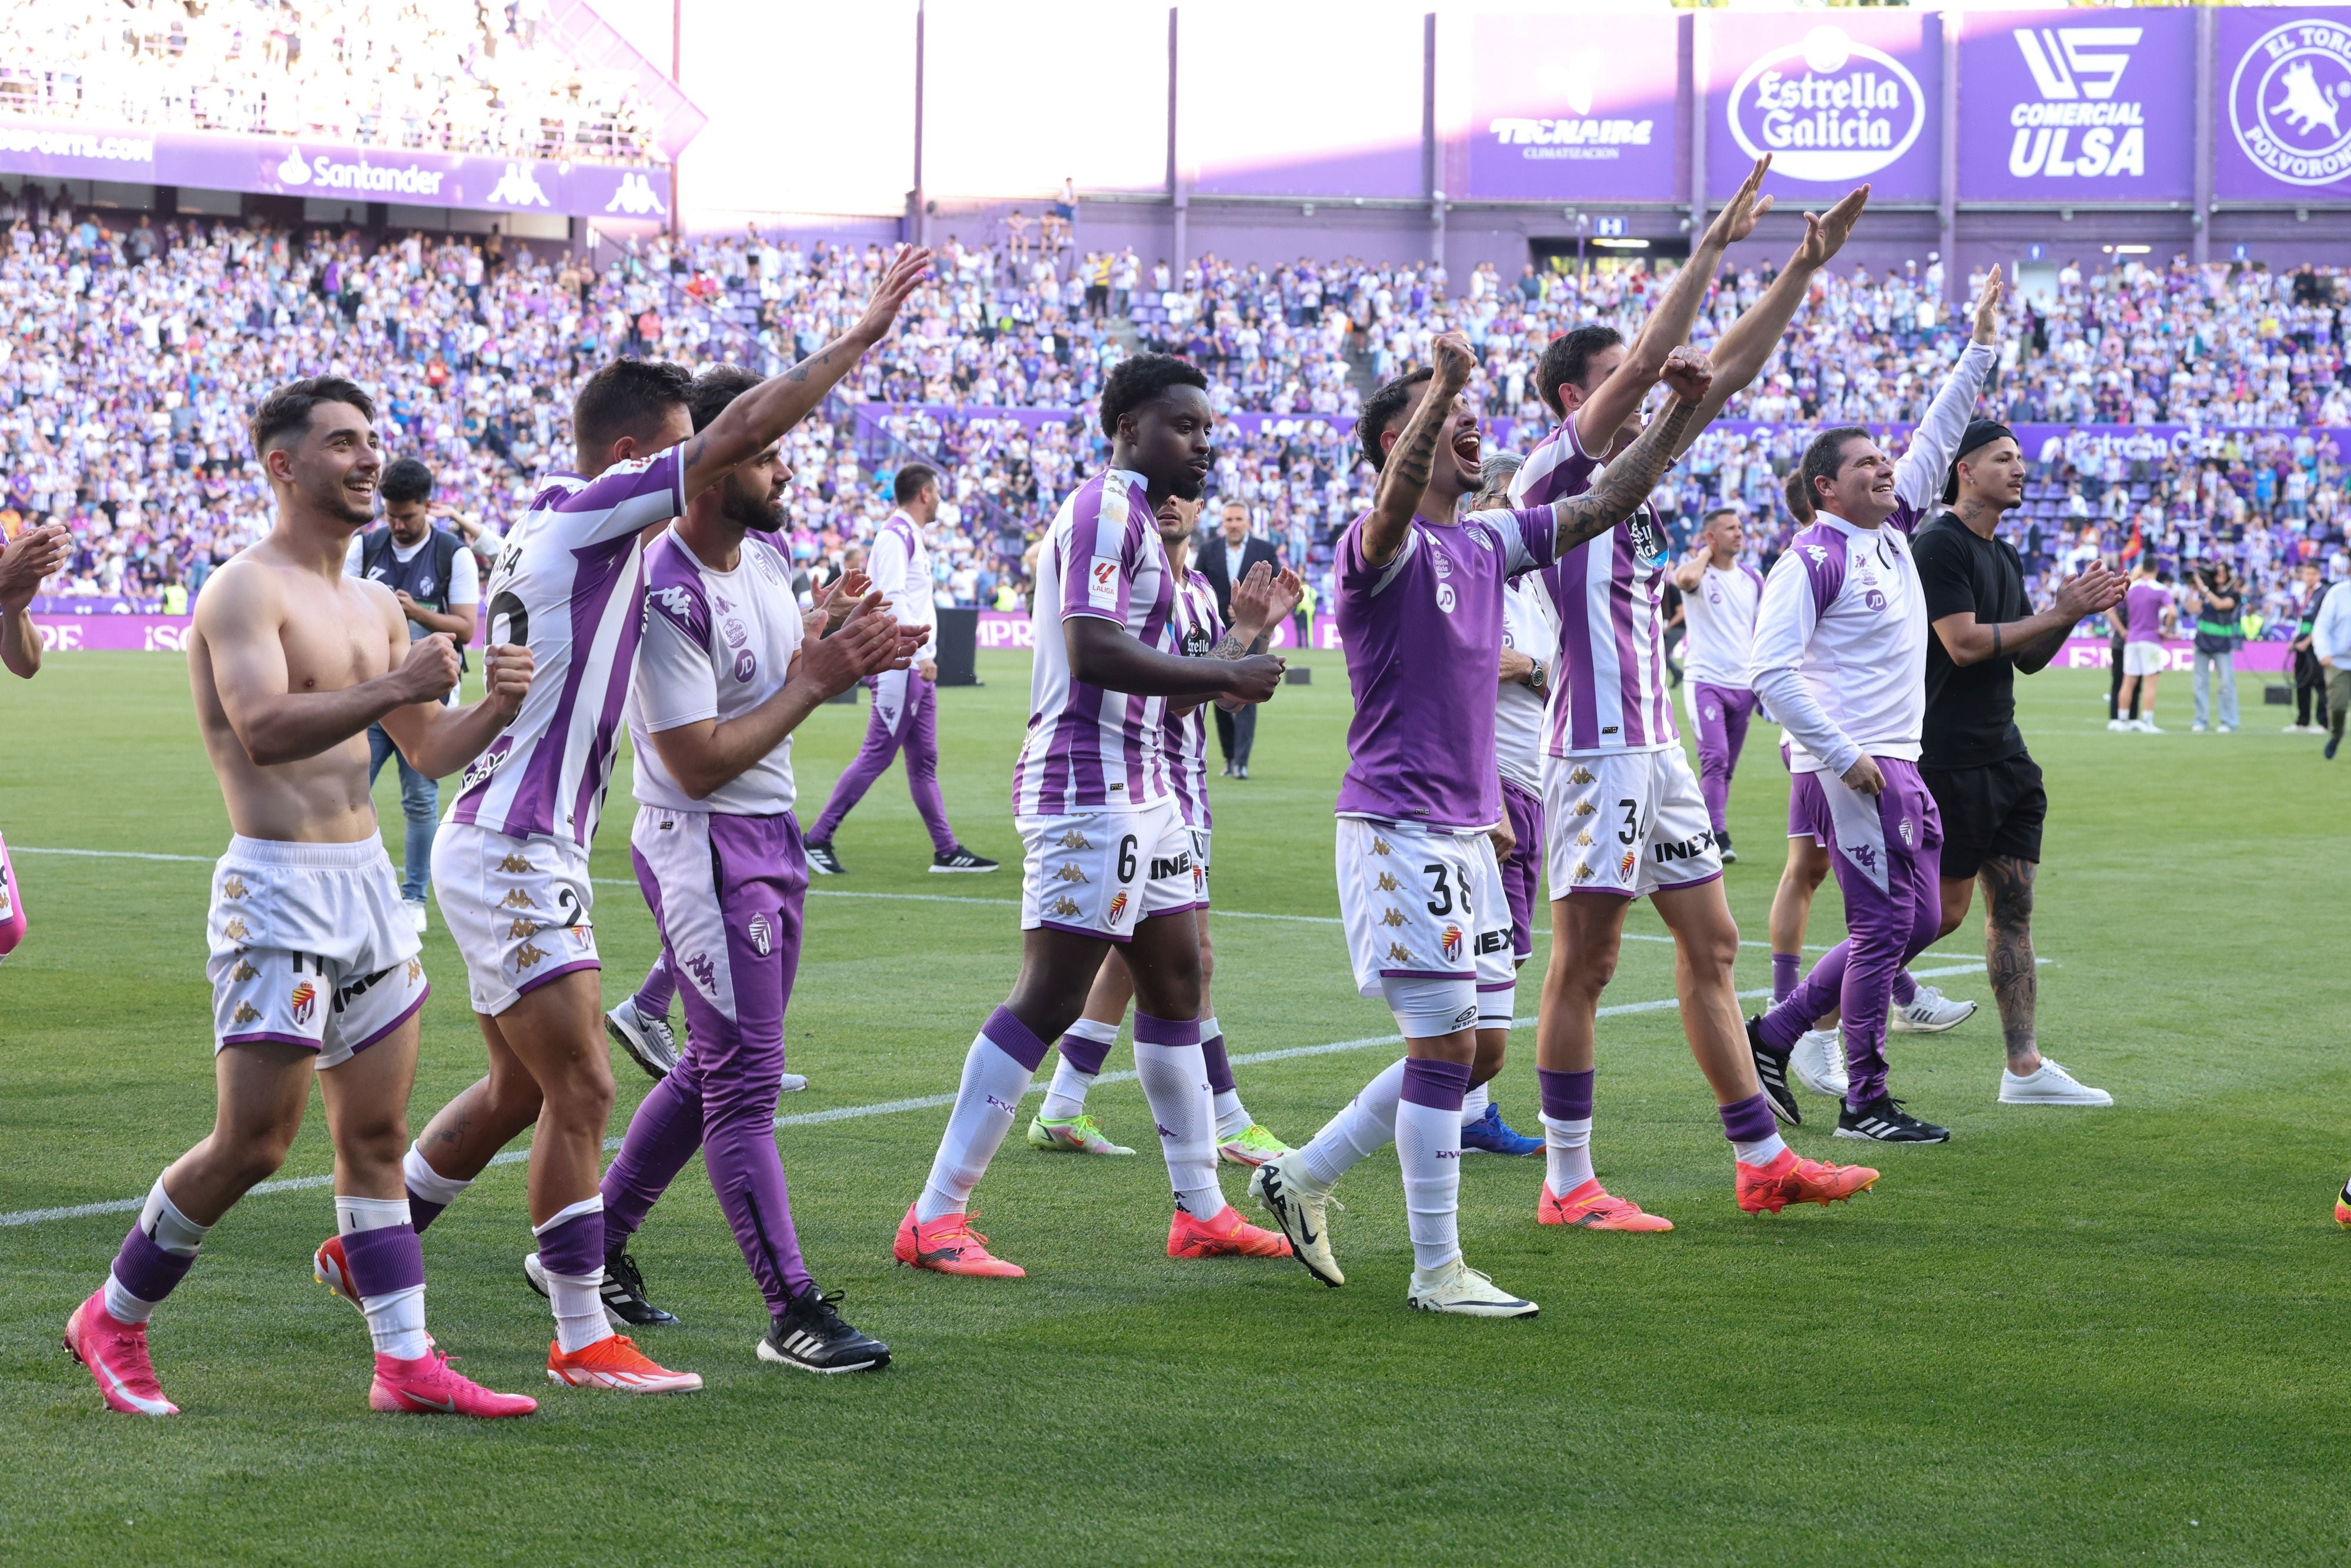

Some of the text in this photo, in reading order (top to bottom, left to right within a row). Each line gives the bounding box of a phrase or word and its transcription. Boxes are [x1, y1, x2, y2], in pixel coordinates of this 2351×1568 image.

[2264, 33, 2296, 59] EL
[1754, 70, 1900, 110] Estrella
[1762, 108, 1891, 148] Galicia
[2010, 102, 2145, 127] COMERCIAL
[1489, 118, 1653, 145] TECNAIRE
[2008, 126, 2145, 177] ULSA
[313, 156, 444, 195] Santander
[1093, 584, 1114, 595] LALIGA
[1440, 590, 1453, 606] JD
[1870, 594, 1883, 608] JD
[726, 624, 742, 637] Estrella
[729, 631, 744, 643] Galicia
[738, 655, 753, 678] JD
[1117, 834, 1138, 883] 6
[1655, 829, 1716, 863] INEX
[1151, 850, 1192, 880] INE
[1424, 864, 1471, 916] 38
